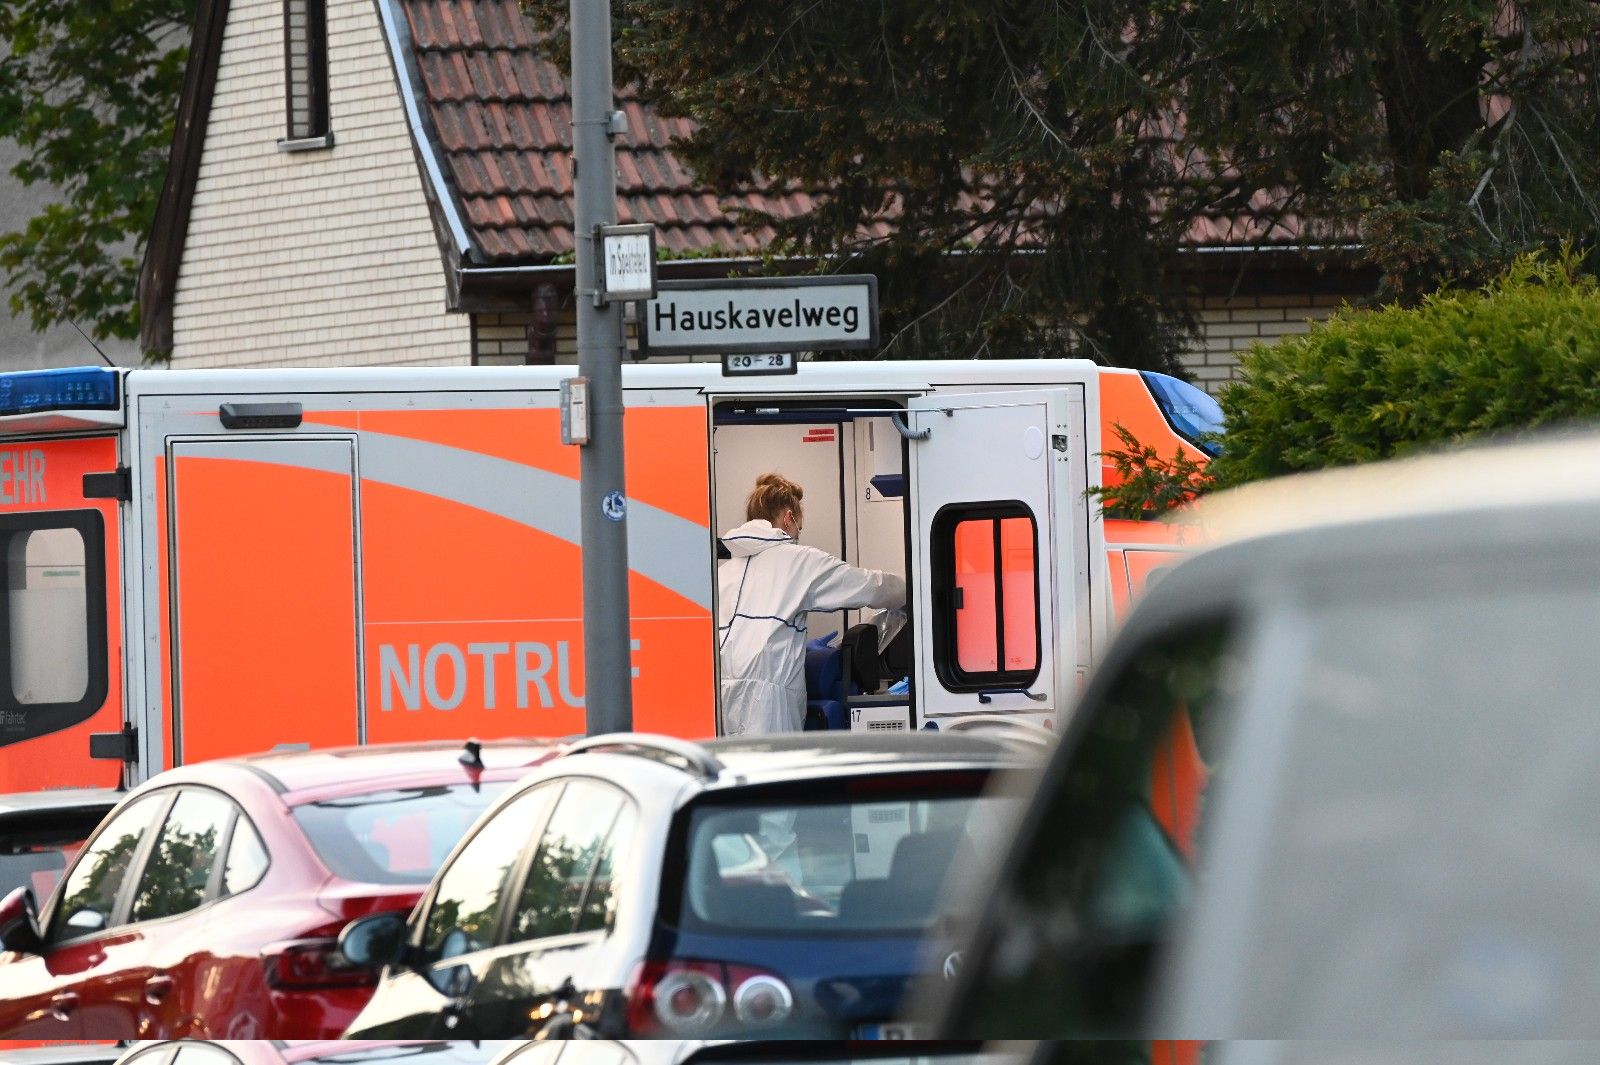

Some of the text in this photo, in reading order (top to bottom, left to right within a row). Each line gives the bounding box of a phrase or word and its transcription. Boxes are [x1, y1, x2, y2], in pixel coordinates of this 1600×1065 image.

[655, 298, 859, 333] Hauskavelweg
[733, 356, 752, 367] 20
[768, 354, 784, 366] 28
[865, 487, 871, 500] 8
[379, 640, 640, 711] NOTRU
[851, 709, 862, 723] 17
